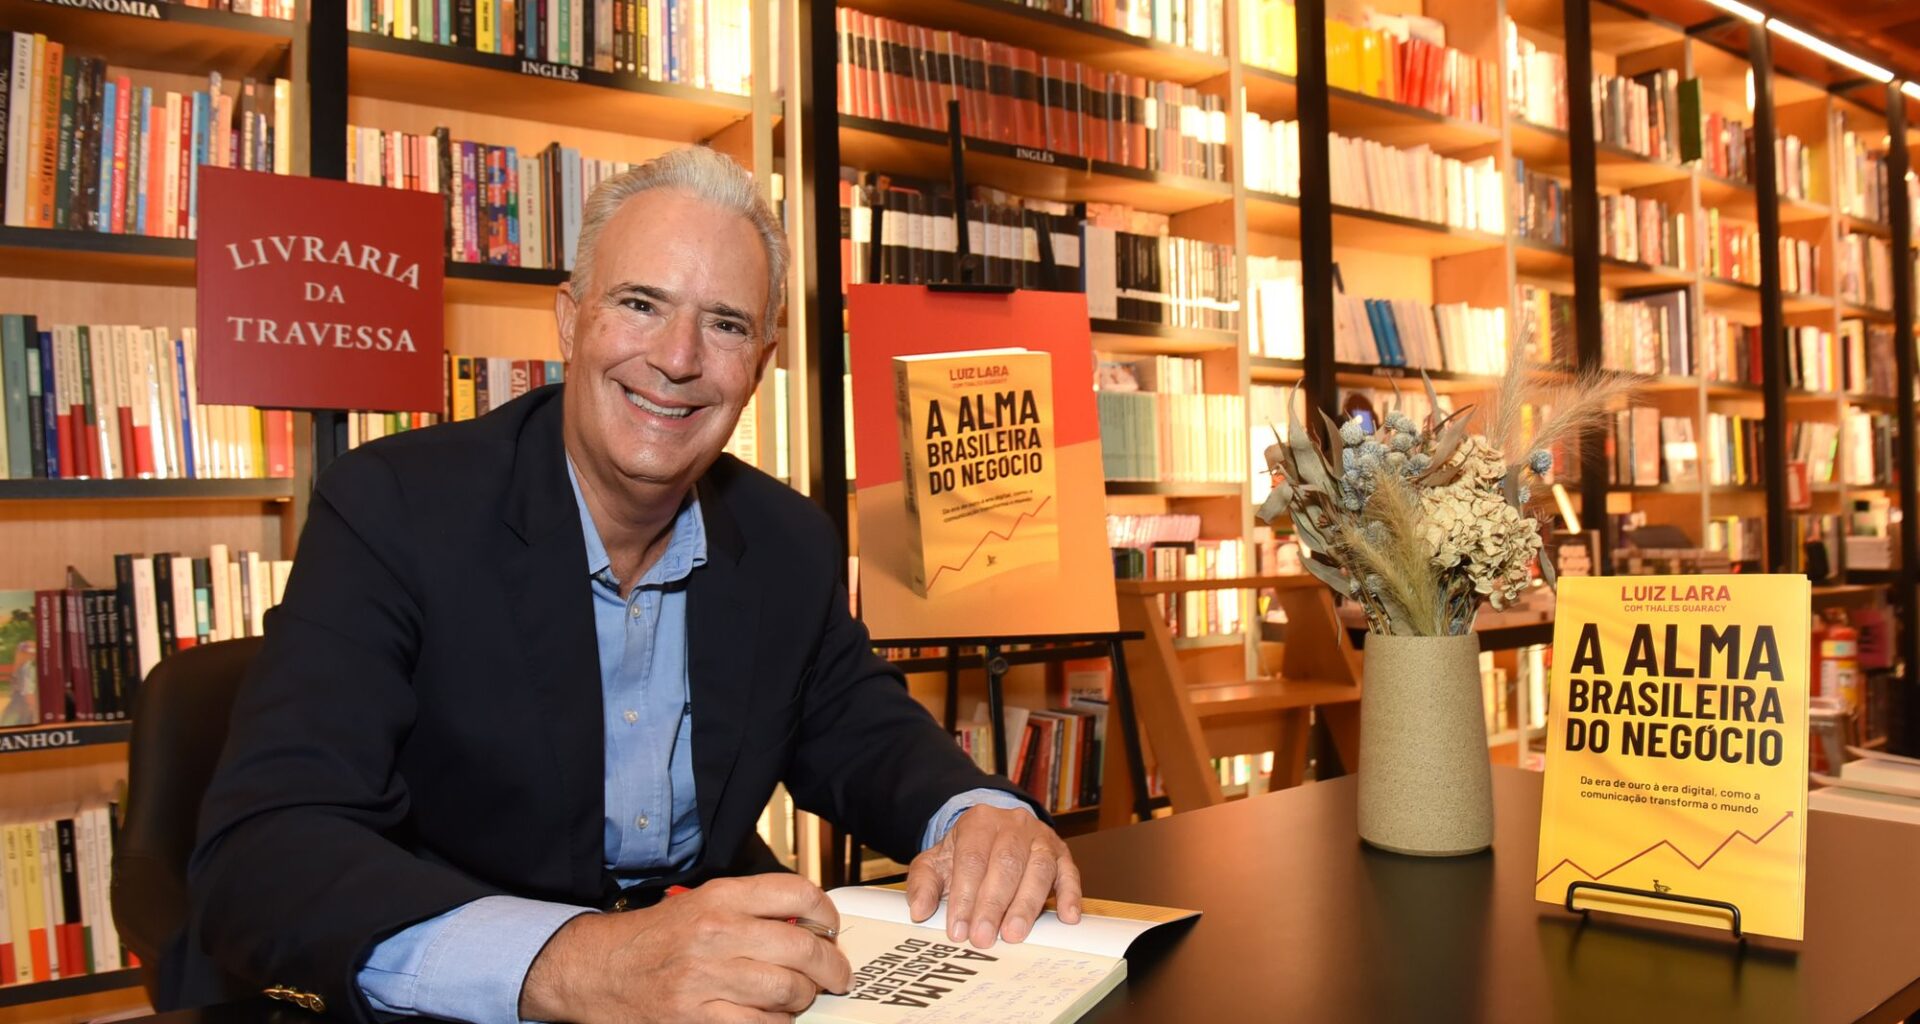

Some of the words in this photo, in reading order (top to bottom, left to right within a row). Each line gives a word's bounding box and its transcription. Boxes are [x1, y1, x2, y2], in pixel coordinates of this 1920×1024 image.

[28, 0, 160, 19] ONOMIA
[520, 60, 580, 82] INGLÊS
[1016, 148, 1054, 163] INGLÊS
[225, 235, 421, 290] LIVRARIA
[304, 281, 345, 304] DA
[227, 316, 417, 353] TRAVESSA
[949, 368, 974, 381] LUIZ
[977, 365, 1009, 379] LARA
[926, 399, 947, 440] A
[957, 389, 1040, 435] ALMA
[927, 427, 1042, 468] BRASILEIRA
[928, 467, 956, 496] DO
[961, 452, 1042, 488] NEGÓCIO
[1621, 585, 1666, 601] LUIZ
[1671, 585, 1731, 601] LARA
[1624, 604, 1643, 612] COM
[1645, 604, 1680, 612] THALES
[1682, 604, 1727, 612] GUARACY
[1570, 622, 1605, 675] A
[1622, 623, 1785, 682] ALMA
[1568, 679, 1785, 724] BRASILEIRA
[0, 731, 80, 751] ANHOL
[1565, 718, 1610, 754] DO
[1621, 721, 1783, 767] NEGÓCIO
[1580, 775, 1593, 785] Da
[1595, 778, 1611, 787] era
[1613, 779, 1626, 788] de
[1628, 782, 1651, 791] ouro
[1653, 782, 1660, 792] à
[1661, 785, 1679, 793] era
[1681, 784, 1717, 798] digital,
[1720, 789, 1751, 800] como
[1753, 792, 1761, 801] a
[1580, 789, 1647, 805] comunicação
[1650, 795, 1709, 810] transforma
[1711, 803, 1718, 811] o
[1720, 803, 1759, 815] mundo
[894, 938, 932, 954] DO
[952, 948, 1000, 962] A
[848, 943, 960, 1001] BRASILEIRA
[852, 952, 909, 992] NEGÓ
[879, 962, 979, 1008] ALMA
